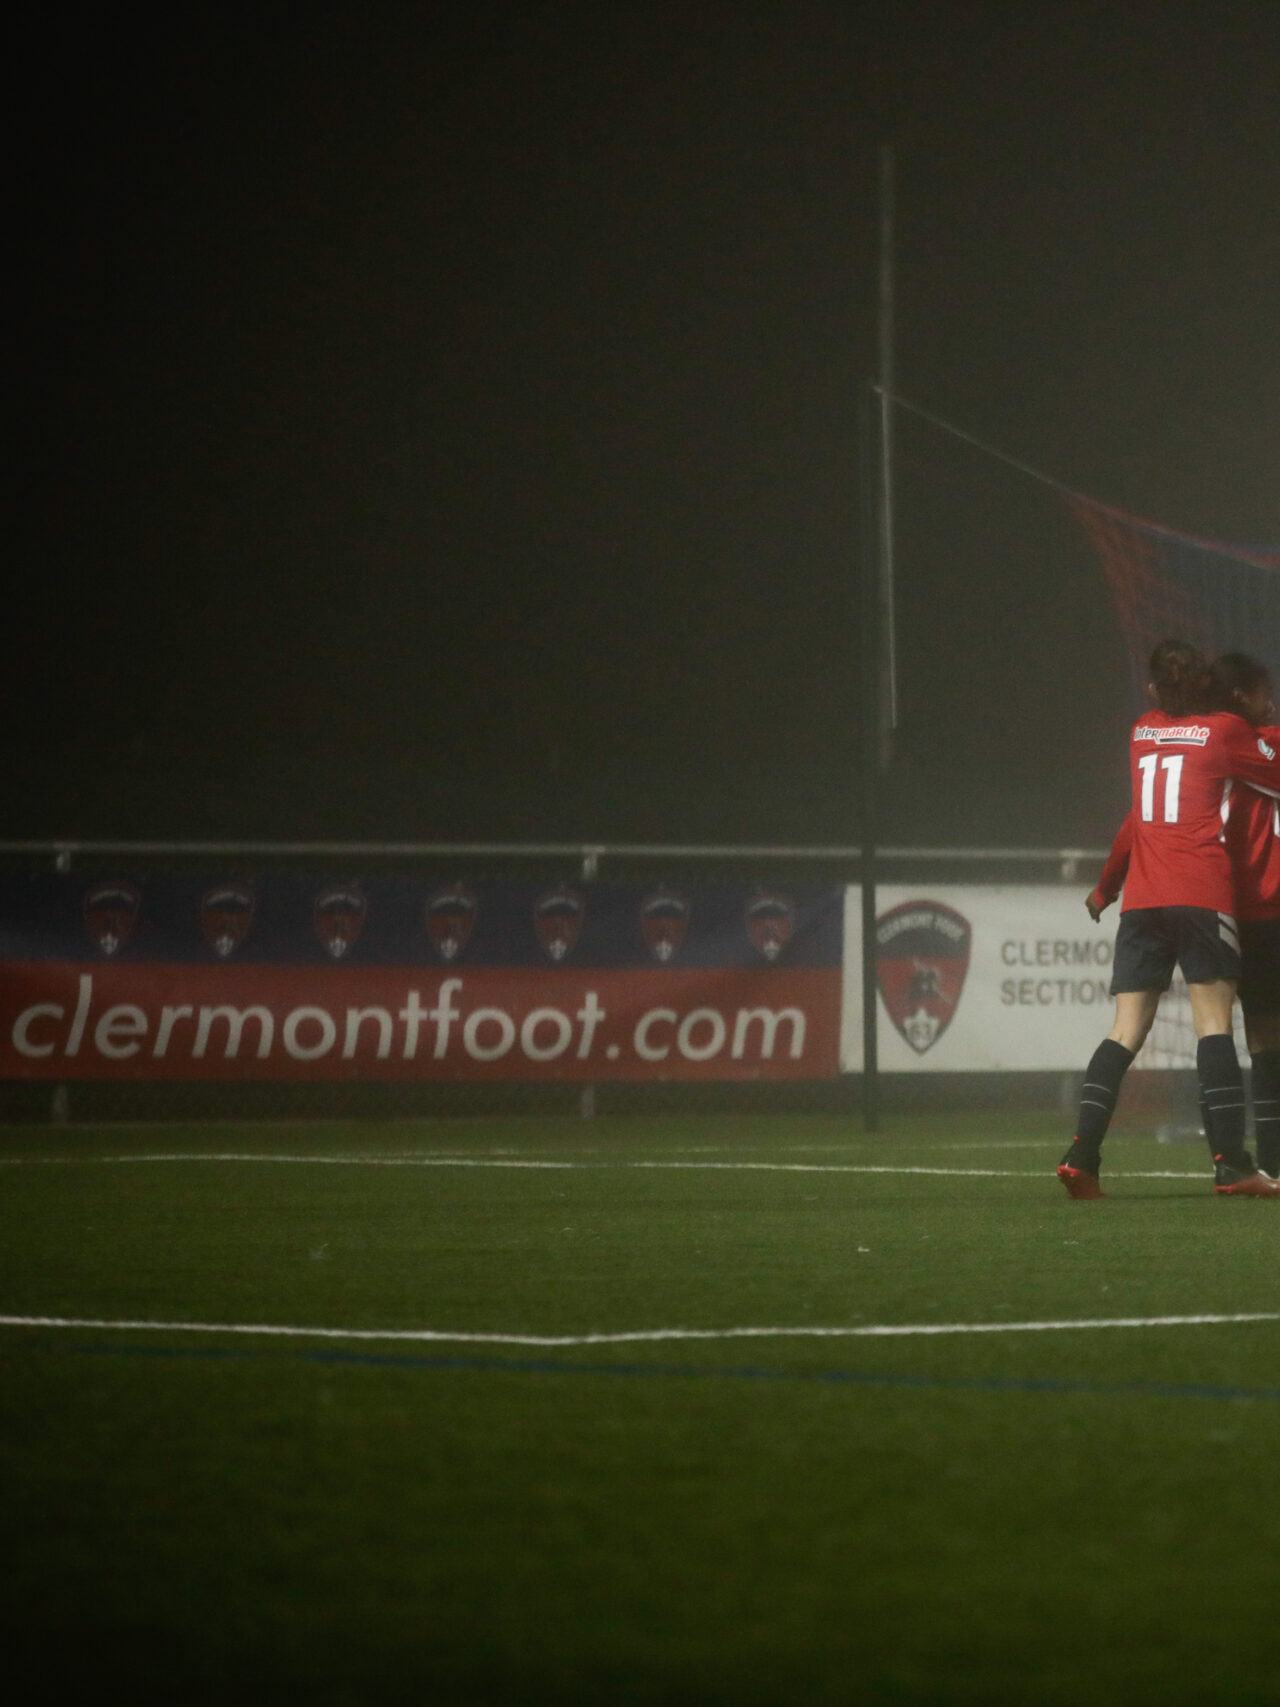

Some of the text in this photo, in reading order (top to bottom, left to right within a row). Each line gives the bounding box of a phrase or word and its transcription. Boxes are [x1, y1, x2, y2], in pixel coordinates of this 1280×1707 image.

[1138, 753, 1184, 823] 11
[1001, 939, 1113, 967] CLERMO
[12, 973, 805, 1062] clermontfoot.com
